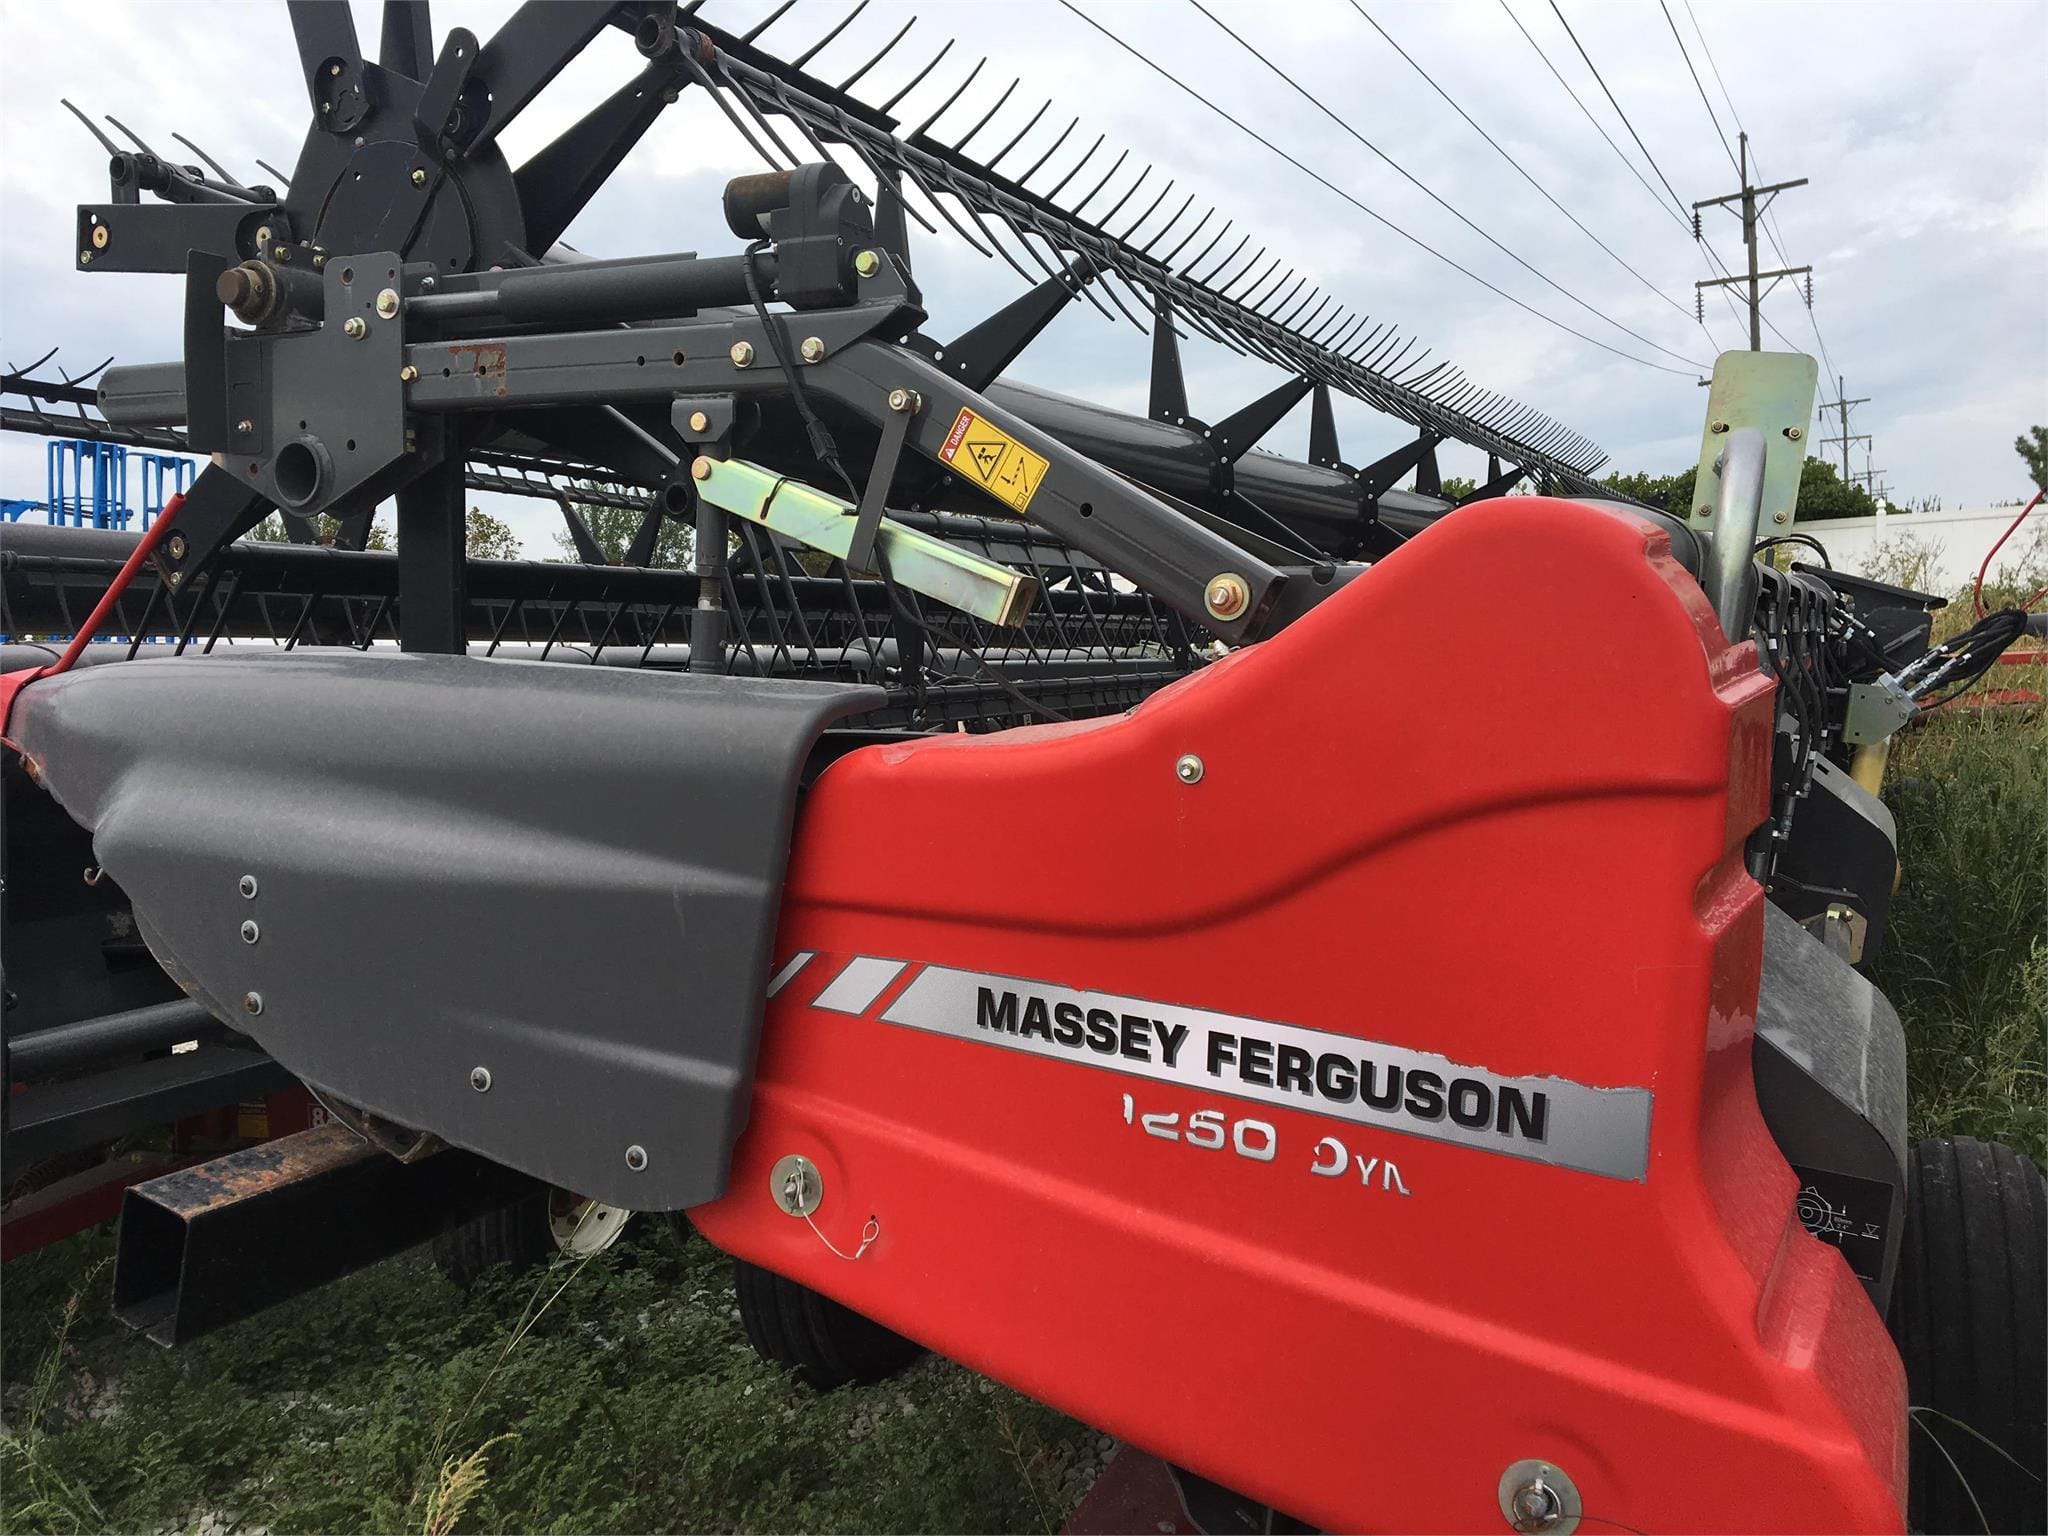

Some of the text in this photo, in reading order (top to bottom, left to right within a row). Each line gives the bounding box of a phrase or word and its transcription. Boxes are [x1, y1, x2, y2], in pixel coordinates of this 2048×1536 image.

[950, 415, 971, 446] DANGER
[977, 986, 1549, 1144] MASSEY FERGUSON
[1123, 1093, 1277, 1163] 250
